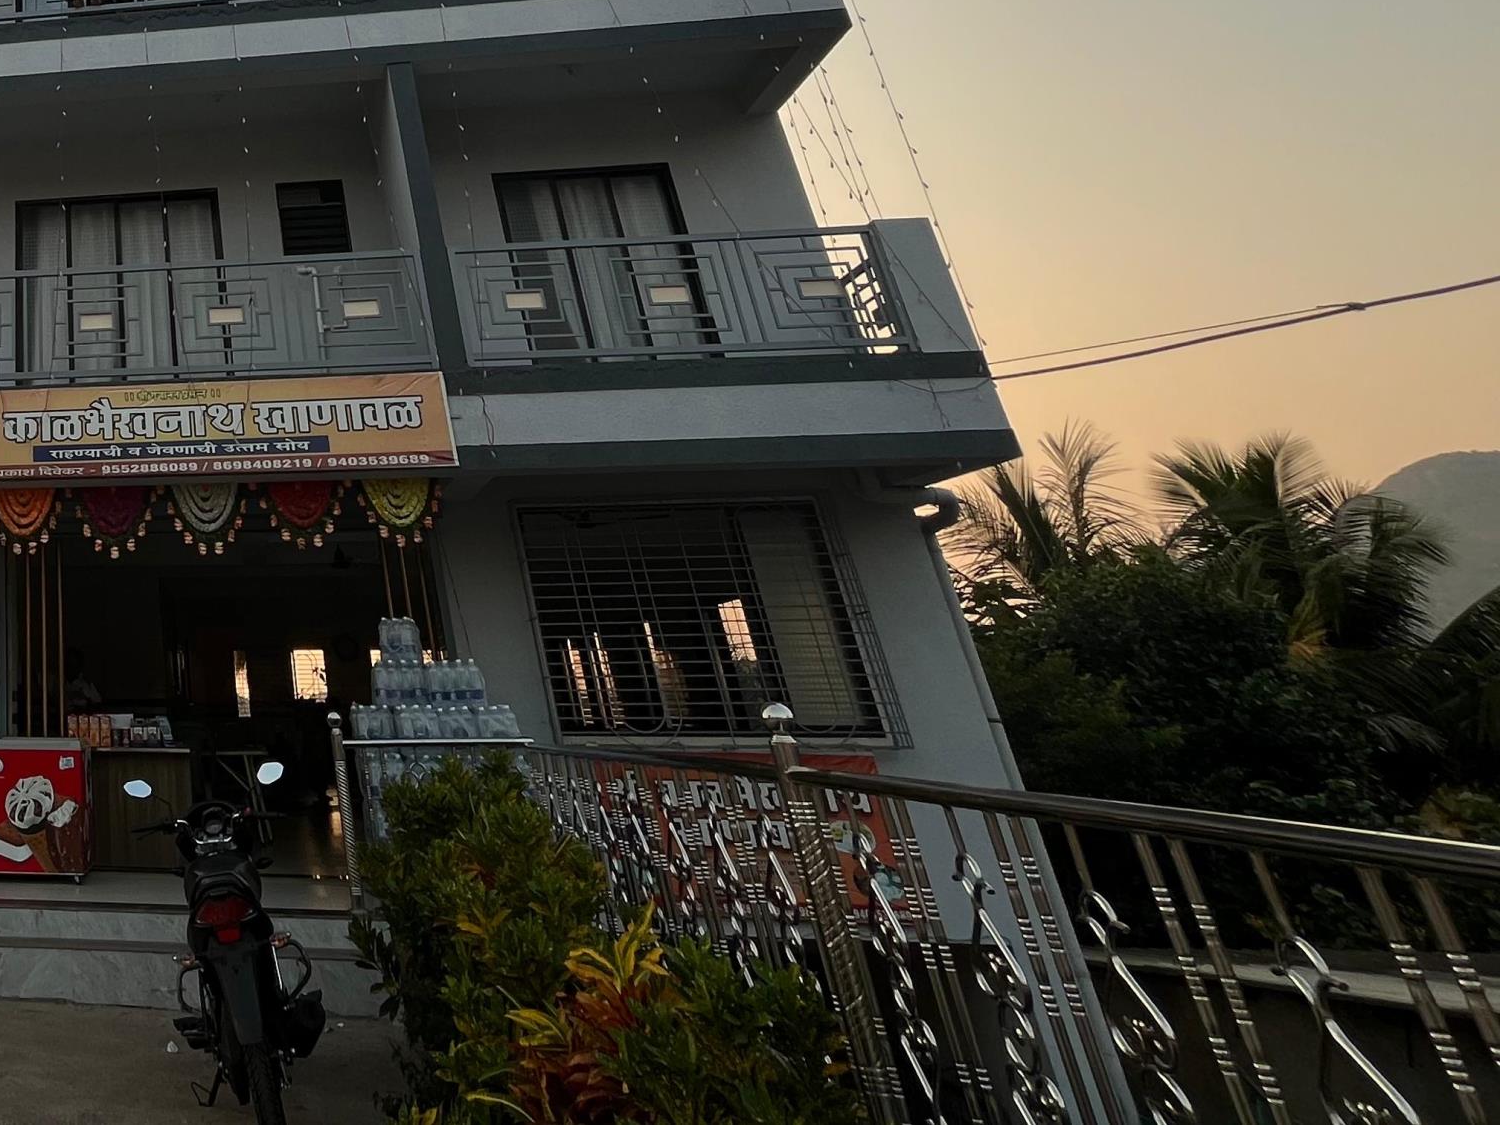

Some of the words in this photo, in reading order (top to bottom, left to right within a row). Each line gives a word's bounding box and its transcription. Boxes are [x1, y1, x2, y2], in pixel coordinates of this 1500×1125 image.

[250, 395, 423, 434] खाणावळ
[127, 447, 141, 457] व
[221, 441, 269, 453] उत्तम
[273, 437, 311, 451] सोय
